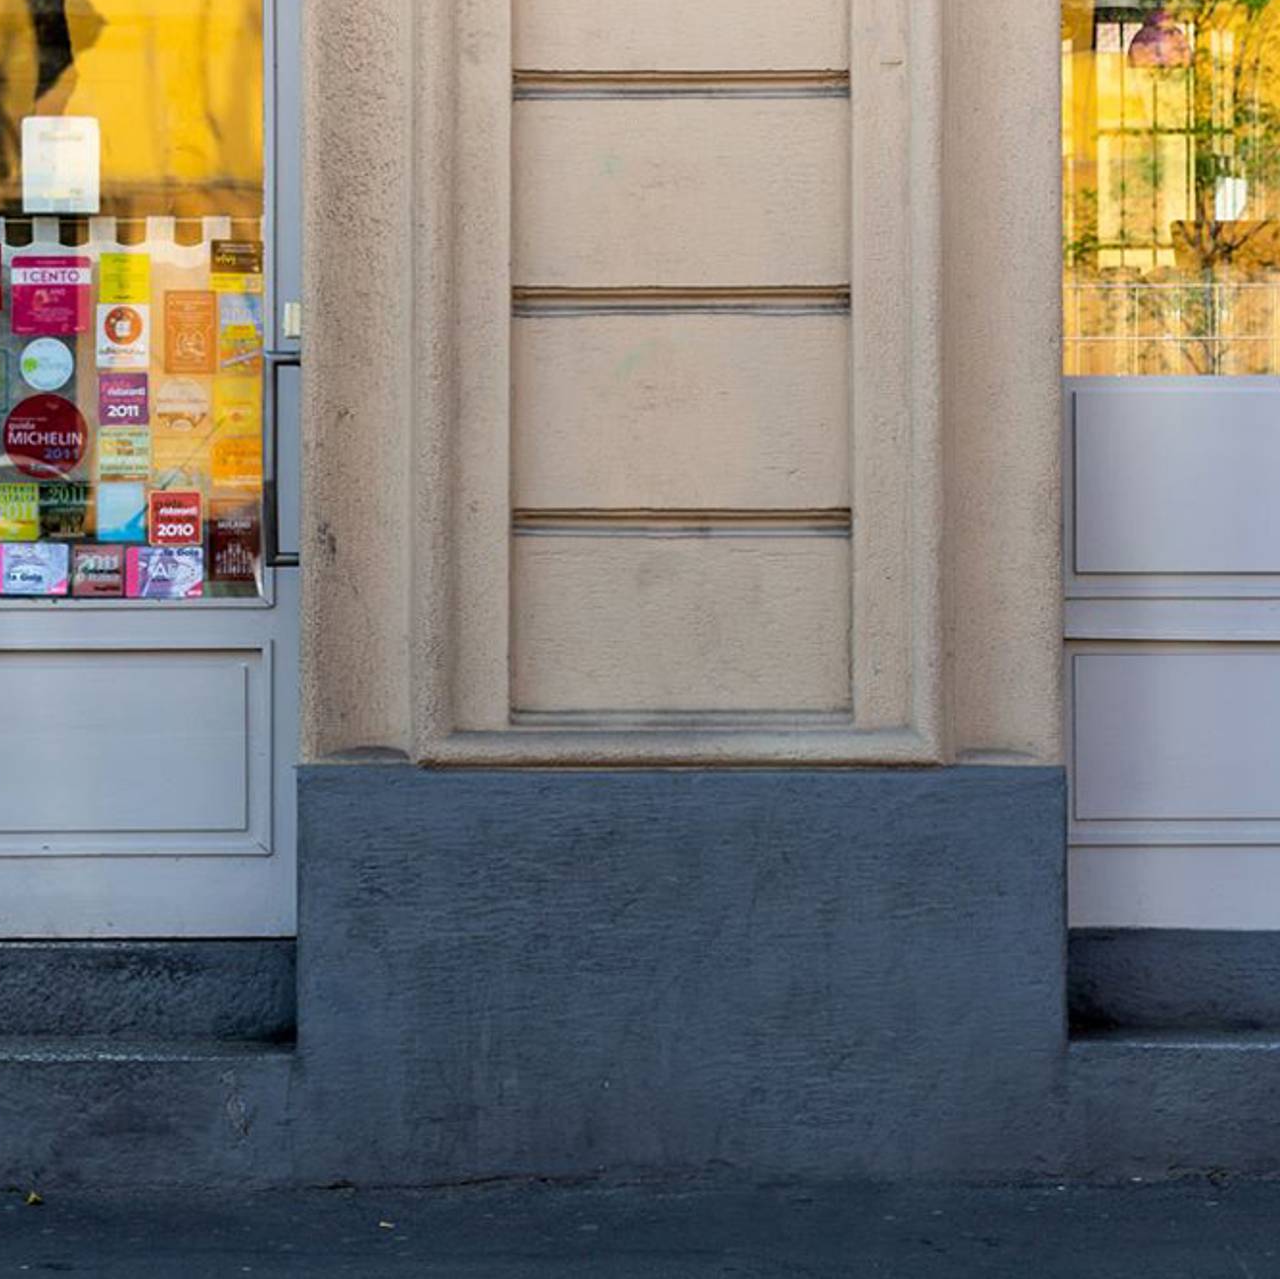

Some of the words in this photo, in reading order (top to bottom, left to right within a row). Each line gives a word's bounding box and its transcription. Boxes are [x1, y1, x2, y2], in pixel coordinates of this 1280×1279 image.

[30, 270, 80, 282] CENTO
[107, 404, 139, 418] 2011
[8, 431, 82, 446] MICHELIN
[44, 449, 79, 460] 2011
[48, 485, 86, 503] 2011
[157, 523, 194, 537] 2010
